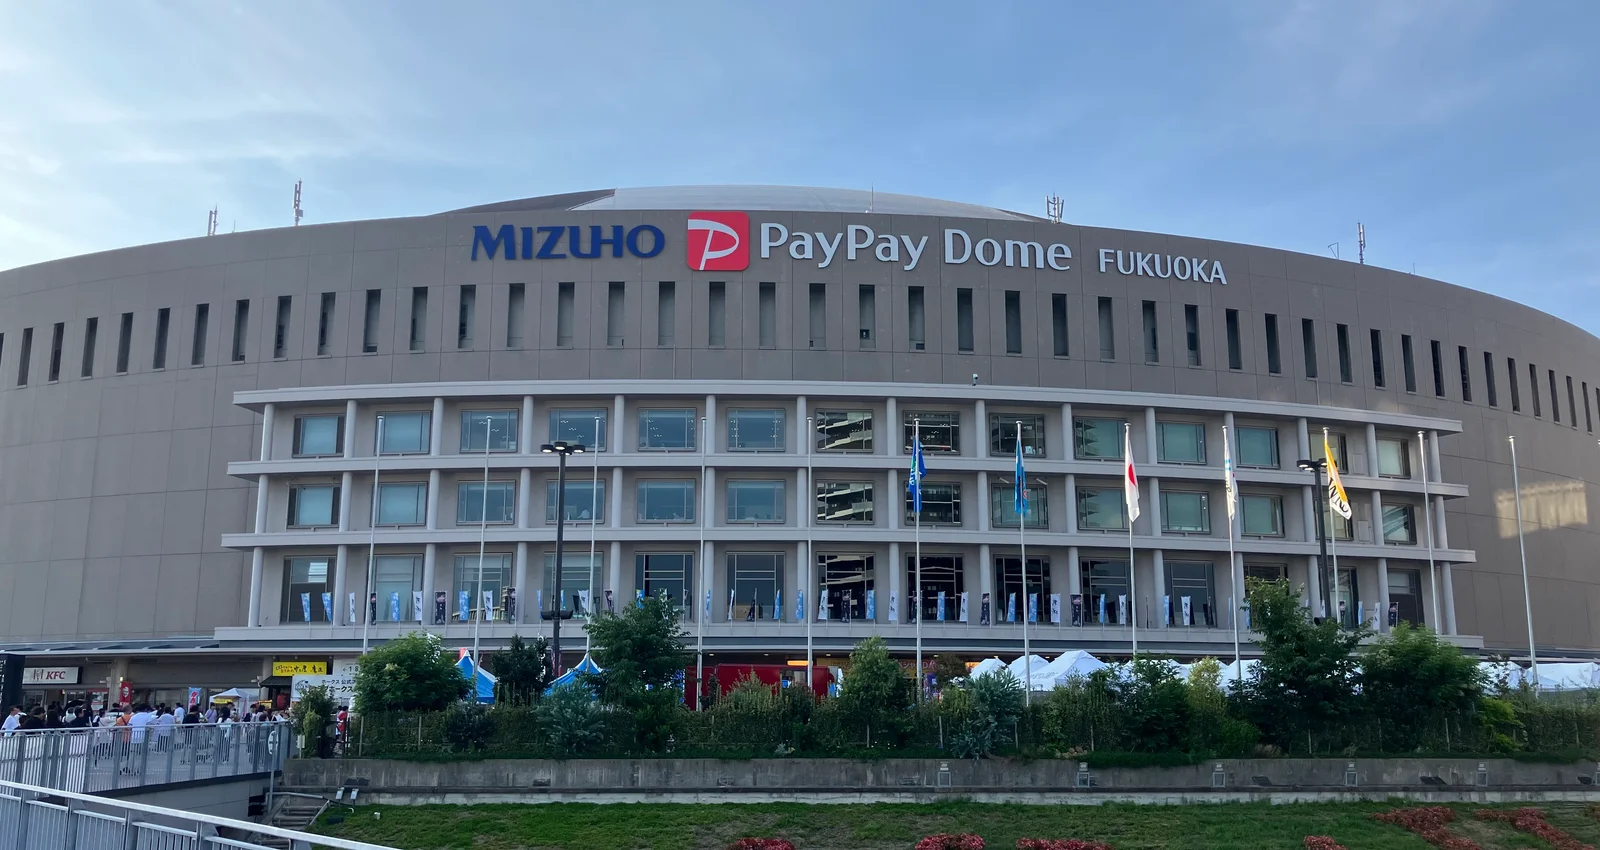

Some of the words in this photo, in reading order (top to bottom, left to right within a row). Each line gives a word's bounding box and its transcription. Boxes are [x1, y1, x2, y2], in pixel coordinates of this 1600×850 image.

[471, 224, 666, 261] MIZUHO
[760, 222, 929, 271] PayPay
[944, 228, 1072, 271] Dome
[1099, 248, 1228, 285] FUKUOKA
[46, 670, 66, 680] KFC
